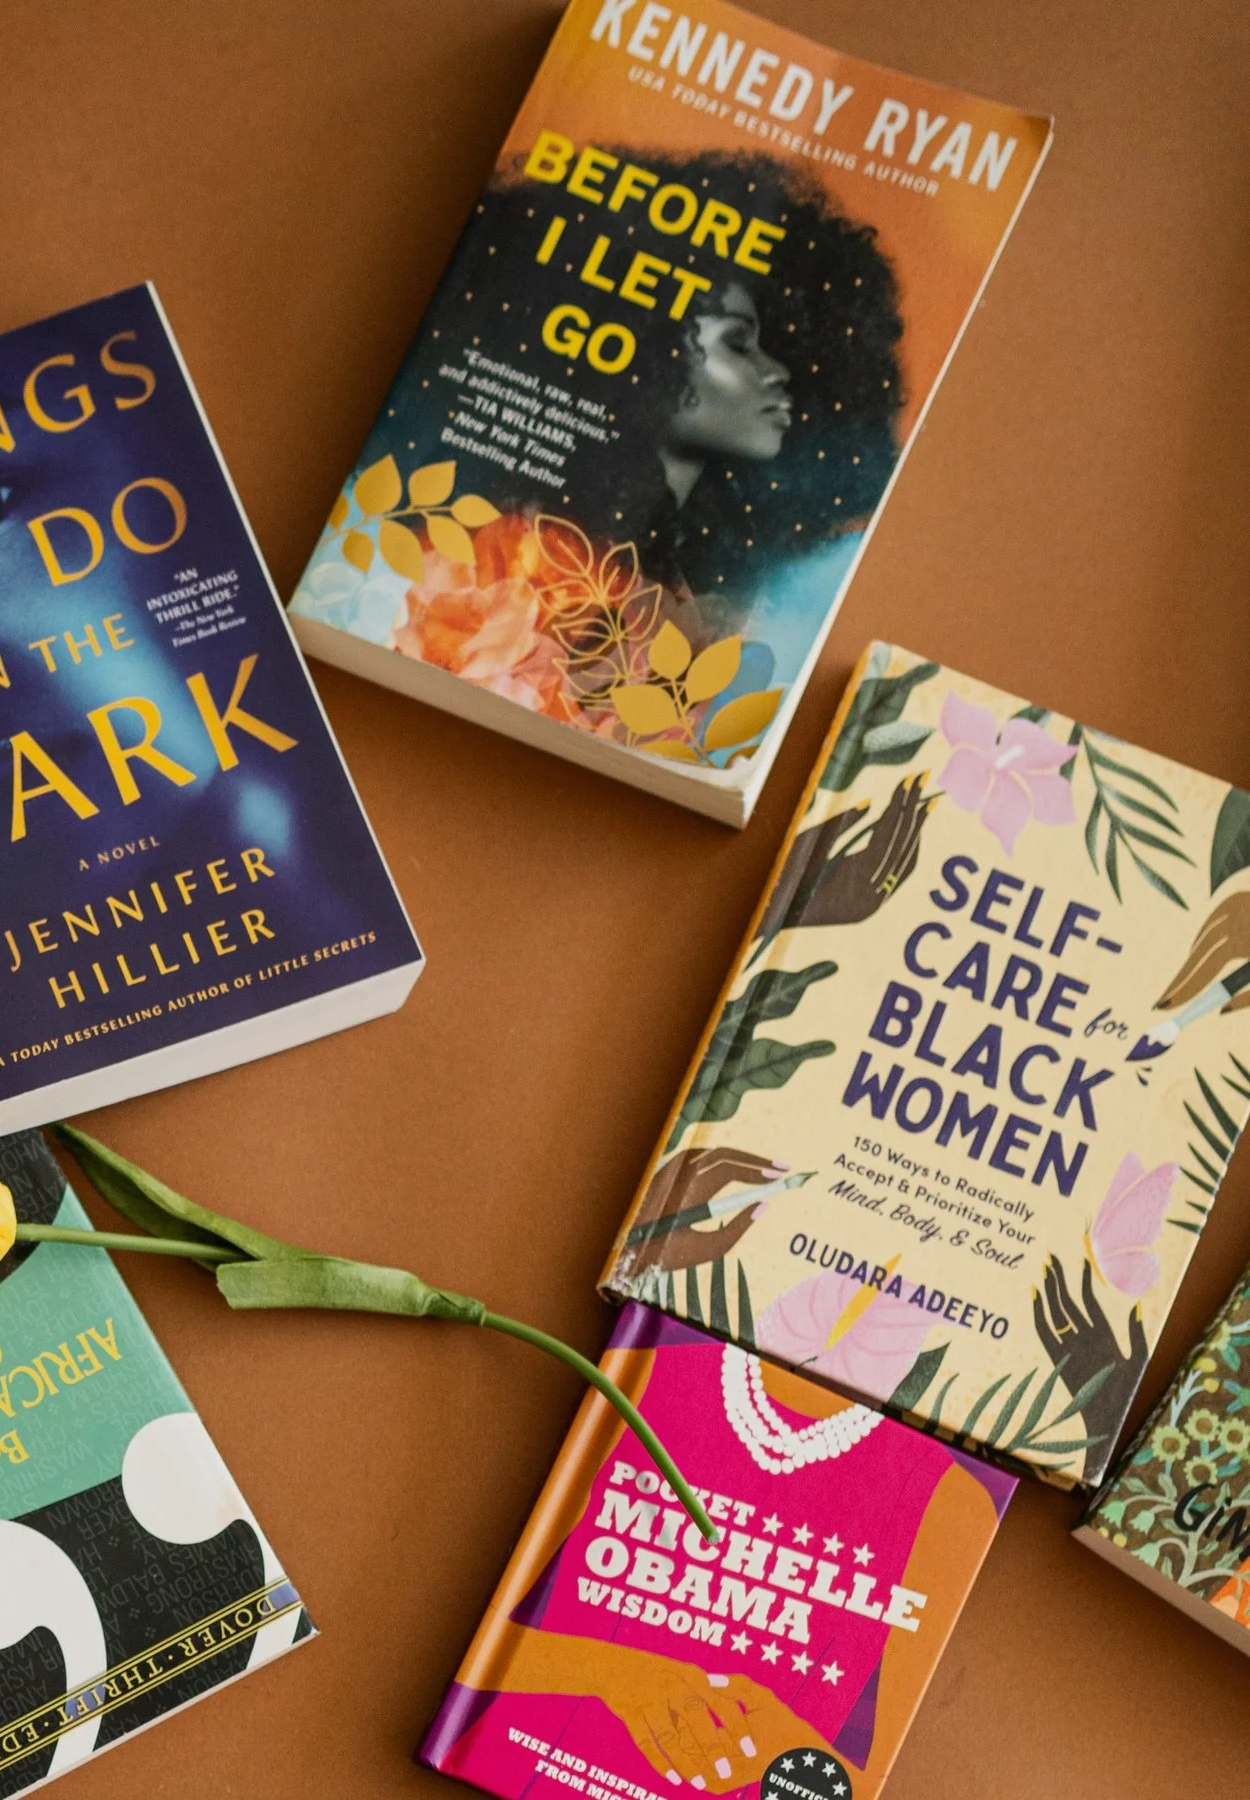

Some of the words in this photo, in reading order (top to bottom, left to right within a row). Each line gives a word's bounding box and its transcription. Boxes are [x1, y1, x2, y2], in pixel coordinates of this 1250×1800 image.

[591, 0, 853, 133] KENNEDY
[864, 99, 1017, 191] RYAN
[627, 65, 667, 92] USA
[671, 82, 731, 119] TODAY
[733, 110, 856, 169] BESTSELLING
[863, 161, 940, 196] AUTHOR
[524, 129, 785, 273] BEFORE
[535, 216, 567, 264] I
[581, 235, 712, 320] LET
[541, 304, 637, 374] GO
[26, 477, 186, 588] DO
[27, 612, 136, 674] THE
[78, 857, 91, 873] A
[95, 834, 161, 866] NOVEL
[4, 847, 276, 973] JENNIFER
[928, 854, 1123, 958] SELF-
[9, 1037, 60, 1064] TODAY
[62, 1003, 164, 1047] BESTSELLING
[166, 981, 231, 1013] AUTHOR
[232, 973, 253, 990] OF
[257, 953, 310, 982] LITTLE
[312, 930, 378, 963] SECRETS
[48, 908, 276, 1009] HILLIER
[903, 921, 1090, 1038] CARE
[1082, 1006, 1130, 1040] for
[867, 980, 1116, 1133] BLACK
[841, 1051, 1089, 1197] WOMEN
[826, 1178, 889, 1213] Mind,
[887, 1202, 943, 1243] Body,
[947, 1228, 972, 1248] &
[969, 1237, 1026, 1270] Soul
[832, 1151, 896, 1188] Accept
[895, 1177, 911, 1196] &
[913, 1183, 994, 1230] Prioritize
[997, 1217, 1037, 1246] Your
[852, 1134, 884, 1158] 150
[886, 1146, 931, 1179] Ways
[933, 1168, 952, 1187] to
[953, 1175, 1036, 1225] Radically
[788, 1231, 904, 1300] OLUDARA
[906, 1282, 1011, 1341] ADEEYO
[577, 1576, 727, 1647] WISDOM
[585, 1536, 813, 1645] OBAMA
[594, 1489, 928, 1633] MICHELLE
[176, 1593, 283, 1658] DOVER
[55, 1656, 165, 1728] THRIFT
[507, 1726, 552, 1758] WISE
[548, 1747, 588, 1774] AND
[533, 1758, 588, 1793] FROM
